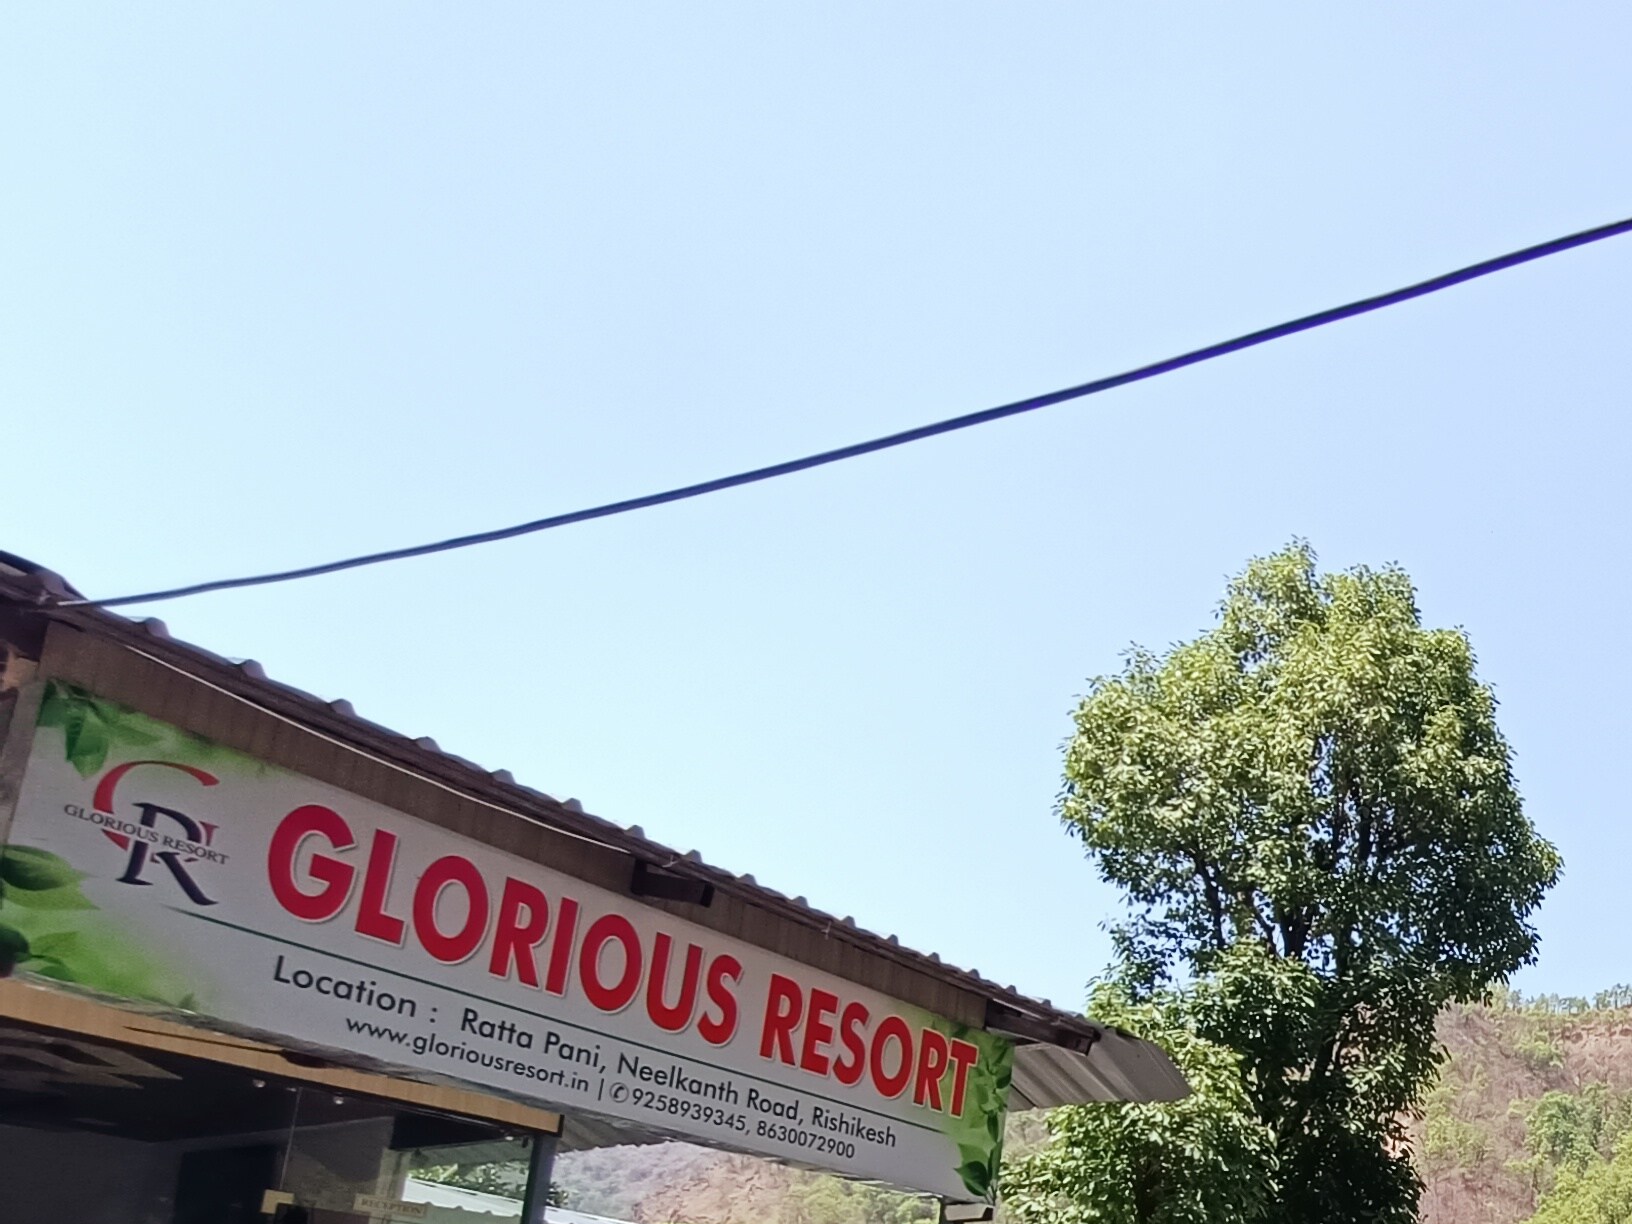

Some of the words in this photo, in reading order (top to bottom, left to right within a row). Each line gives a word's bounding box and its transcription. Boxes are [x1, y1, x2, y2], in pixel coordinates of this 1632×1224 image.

[63, 803, 159, 843] GLORIOUS
[162, 835, 230, 865] RESORT
[267, 804, 743, 1046] GLORIOUS
[760, 973, 978, 1119] RESORT
[273, 955, 417, 1018] Location
[460, 1007, 534, 1050] Ratta
[543, 1031, 607, 1074] Pani,
[617, 1052, 739, 1105] Neelkanth
[748, 1088, 806, 1126] Road,
[812, 1106, 897, 1148] Rishikesh
[345, 1017, 590, 1093] www.gloriousresort.in
[632, 1088, 750, 1136] 9258939345,
[756, 1120, 856, 1159] 8630072900
